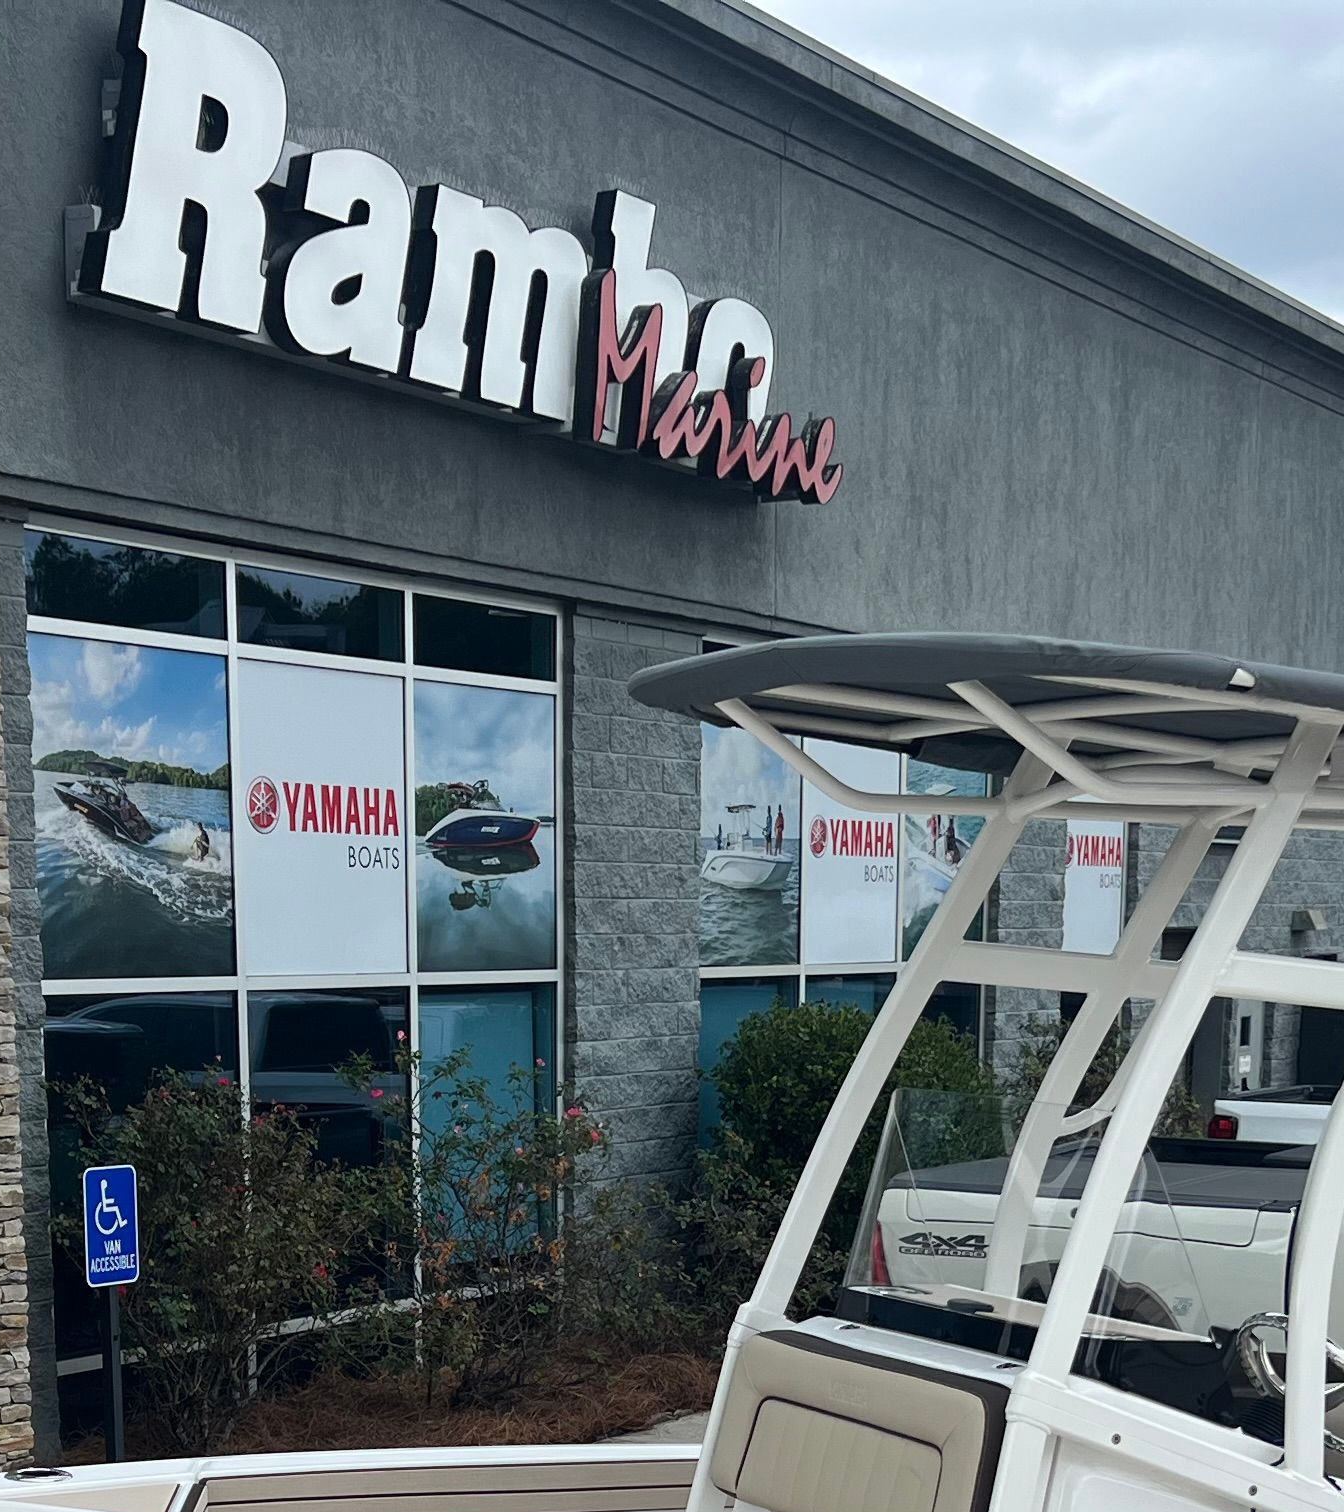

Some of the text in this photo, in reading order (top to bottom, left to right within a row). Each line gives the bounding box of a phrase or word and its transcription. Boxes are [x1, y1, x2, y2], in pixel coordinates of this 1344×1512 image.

[101, 0, 774, 464] Rambo
[592, 267, 843, 505] Marine
[282, 782, 399, 836] YAMAHA
[829, 818, 894, 857] YAMAHA
[1076, 834, 1122, 867] YAMAHA
[348, 845, 400, 869] BOATS
[864, 865, 894, 882] BOATS
[103, 1239, 122, 1255] VAN
[898, 1232, 989, 1251] 4x4
[90, 1253, 136, 1273] ACCESSIBLE
